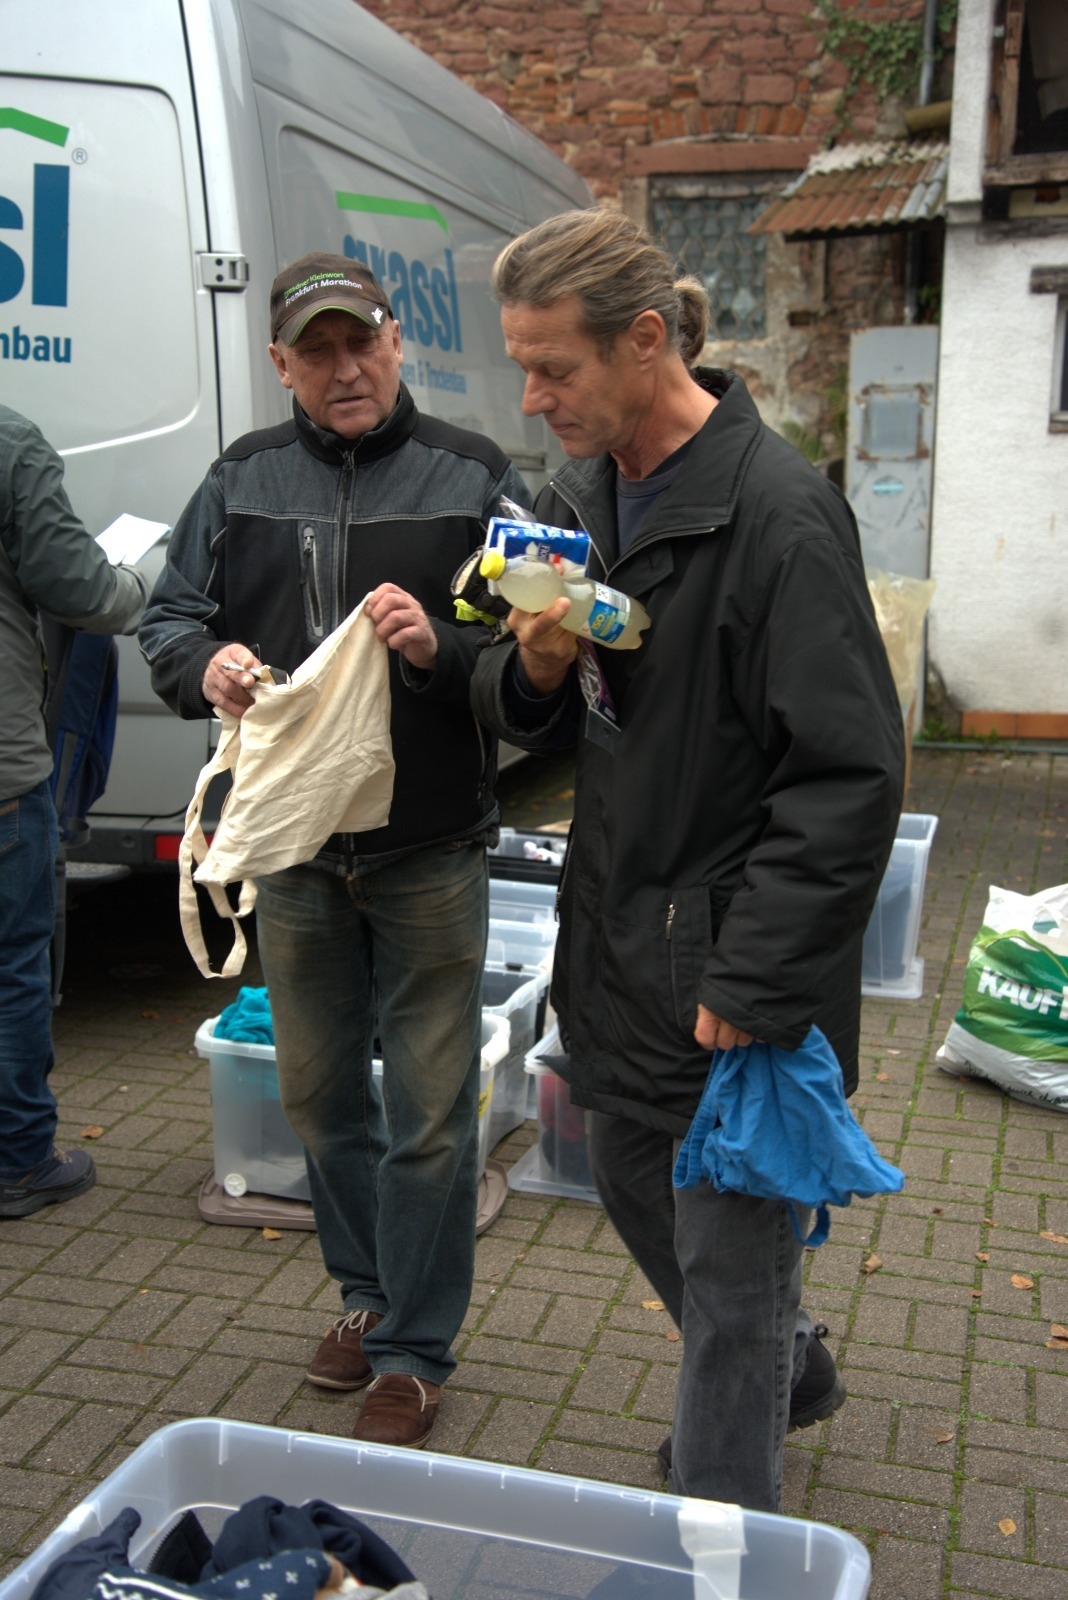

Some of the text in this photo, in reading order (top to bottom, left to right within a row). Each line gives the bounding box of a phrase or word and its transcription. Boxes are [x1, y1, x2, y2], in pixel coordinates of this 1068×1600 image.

[309, 272, 345, 282] Kleinwort
[285, 279, 363, 308] Frankfurt Marathon
